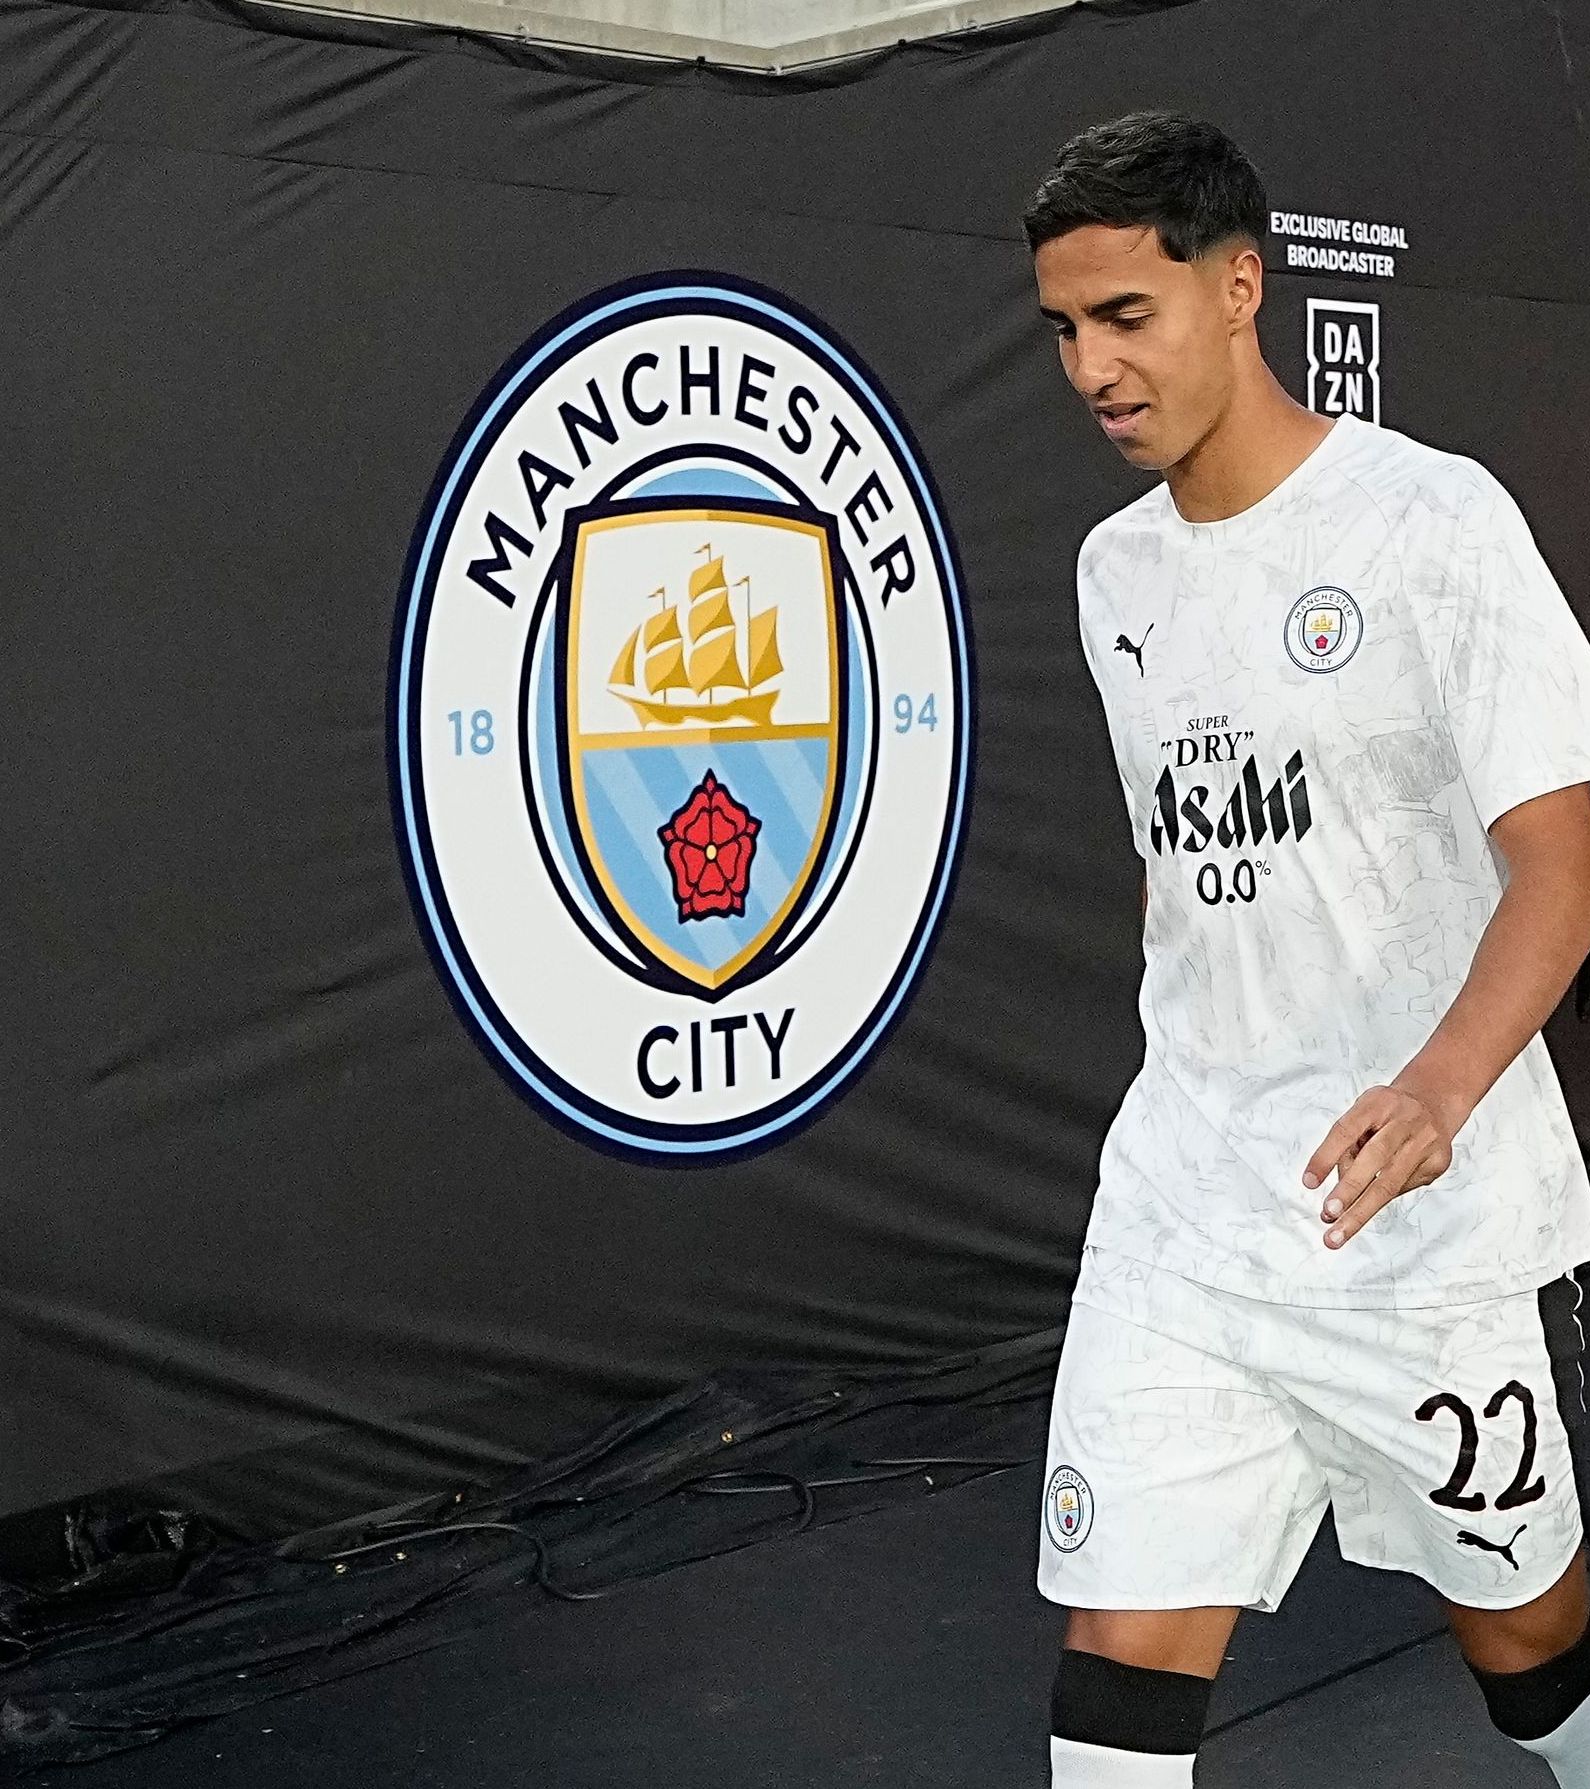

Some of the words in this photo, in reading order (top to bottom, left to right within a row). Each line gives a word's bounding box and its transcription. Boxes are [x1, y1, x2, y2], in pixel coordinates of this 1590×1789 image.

[1270, 211, 1350, 242] EXCLUSIVE
[1352, 221, 1409, 249] GLOBAL
[1287, 244, 1394, 277] BROADCASTER
[465, 344, 917, 613] MANCHESTER
[1294, 593, 1354, 620] MANCHESTER
[1309, 658, 1333, 667] CITY
[446, 709, 495, 756] 18
[892, 692, 939, 734] 94
[1186, 715, 1229, 732] SUPER
[1150, 748, 1313, 857] Asahi
[635, 1006, 796, 1100] CITY
[1414, 1379, 1546, 1513] 22
